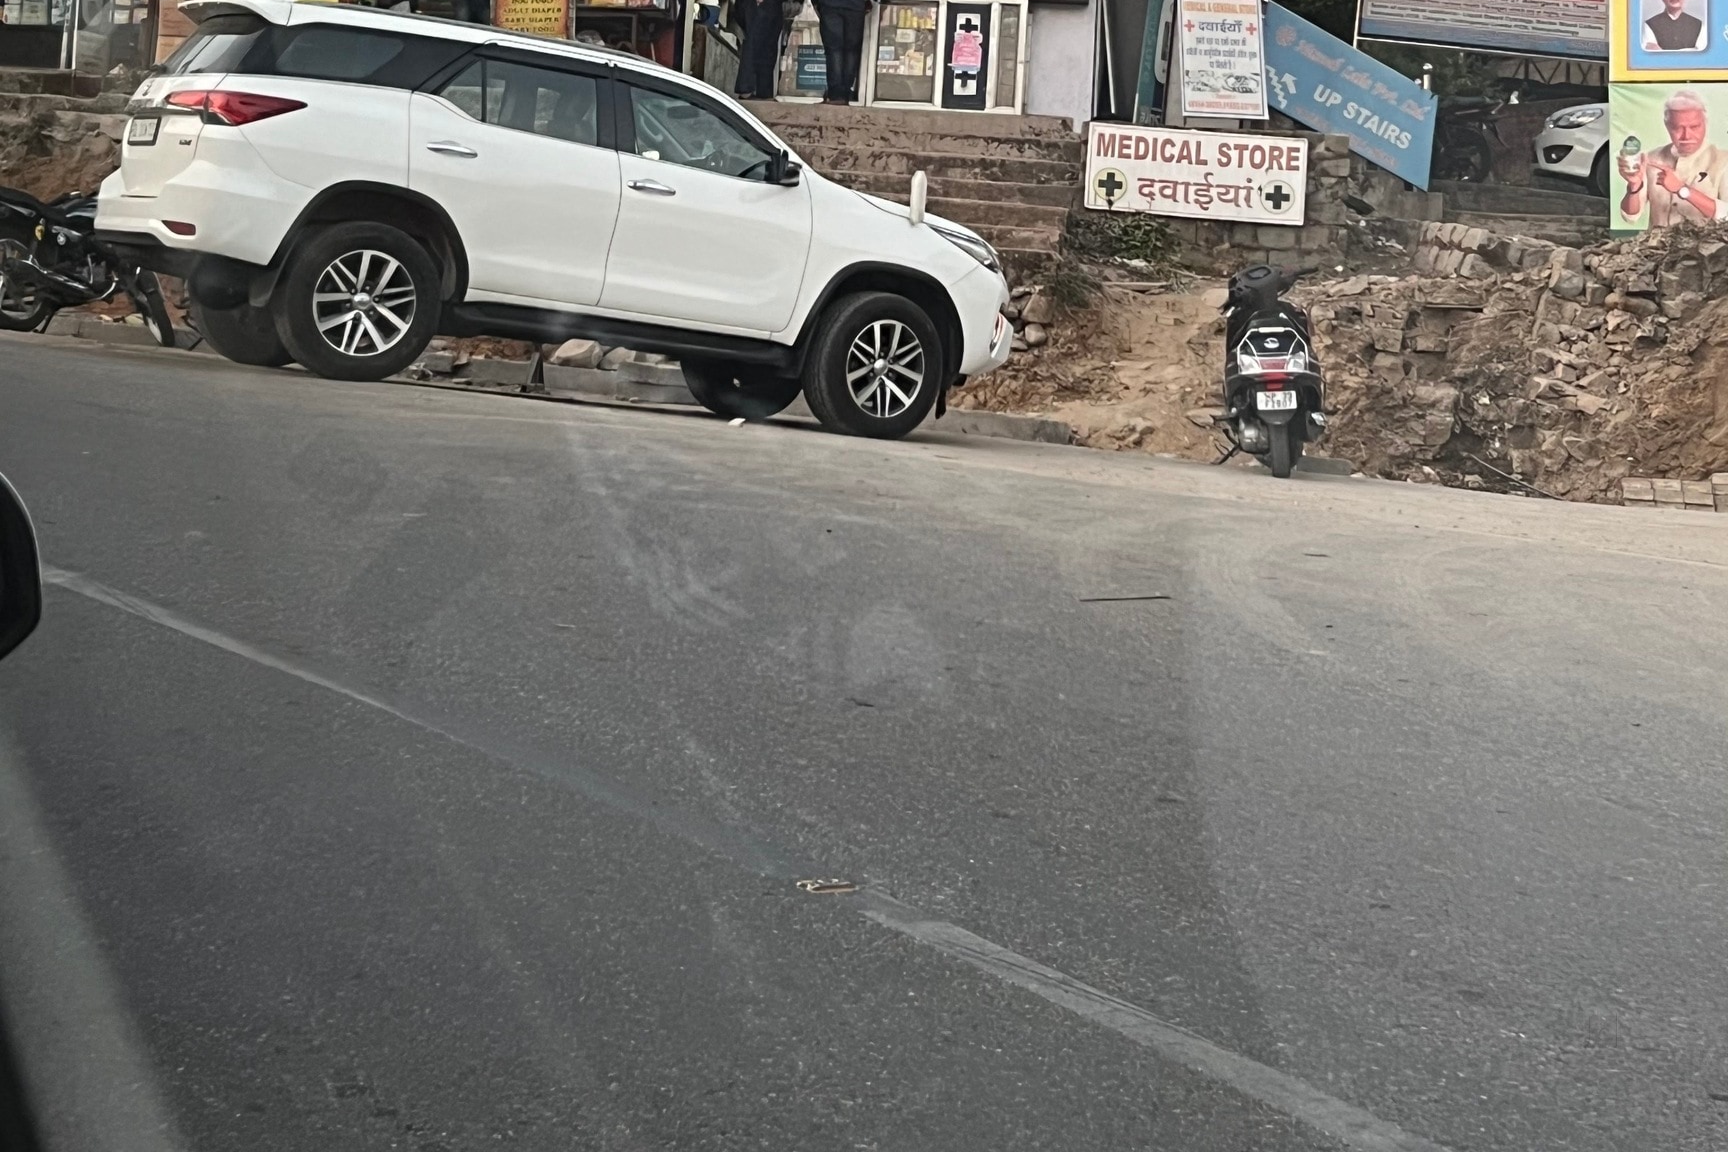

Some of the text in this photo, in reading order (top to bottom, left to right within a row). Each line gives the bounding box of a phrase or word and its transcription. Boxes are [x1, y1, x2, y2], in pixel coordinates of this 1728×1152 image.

[1313, 84, 1343, 107] UP
[1342, 101, 1412, 149] STAIRS
[1096, 132, 1301, 171] MEDICAL STORE
[1138, 172, 1254, 210] दवाईयां
